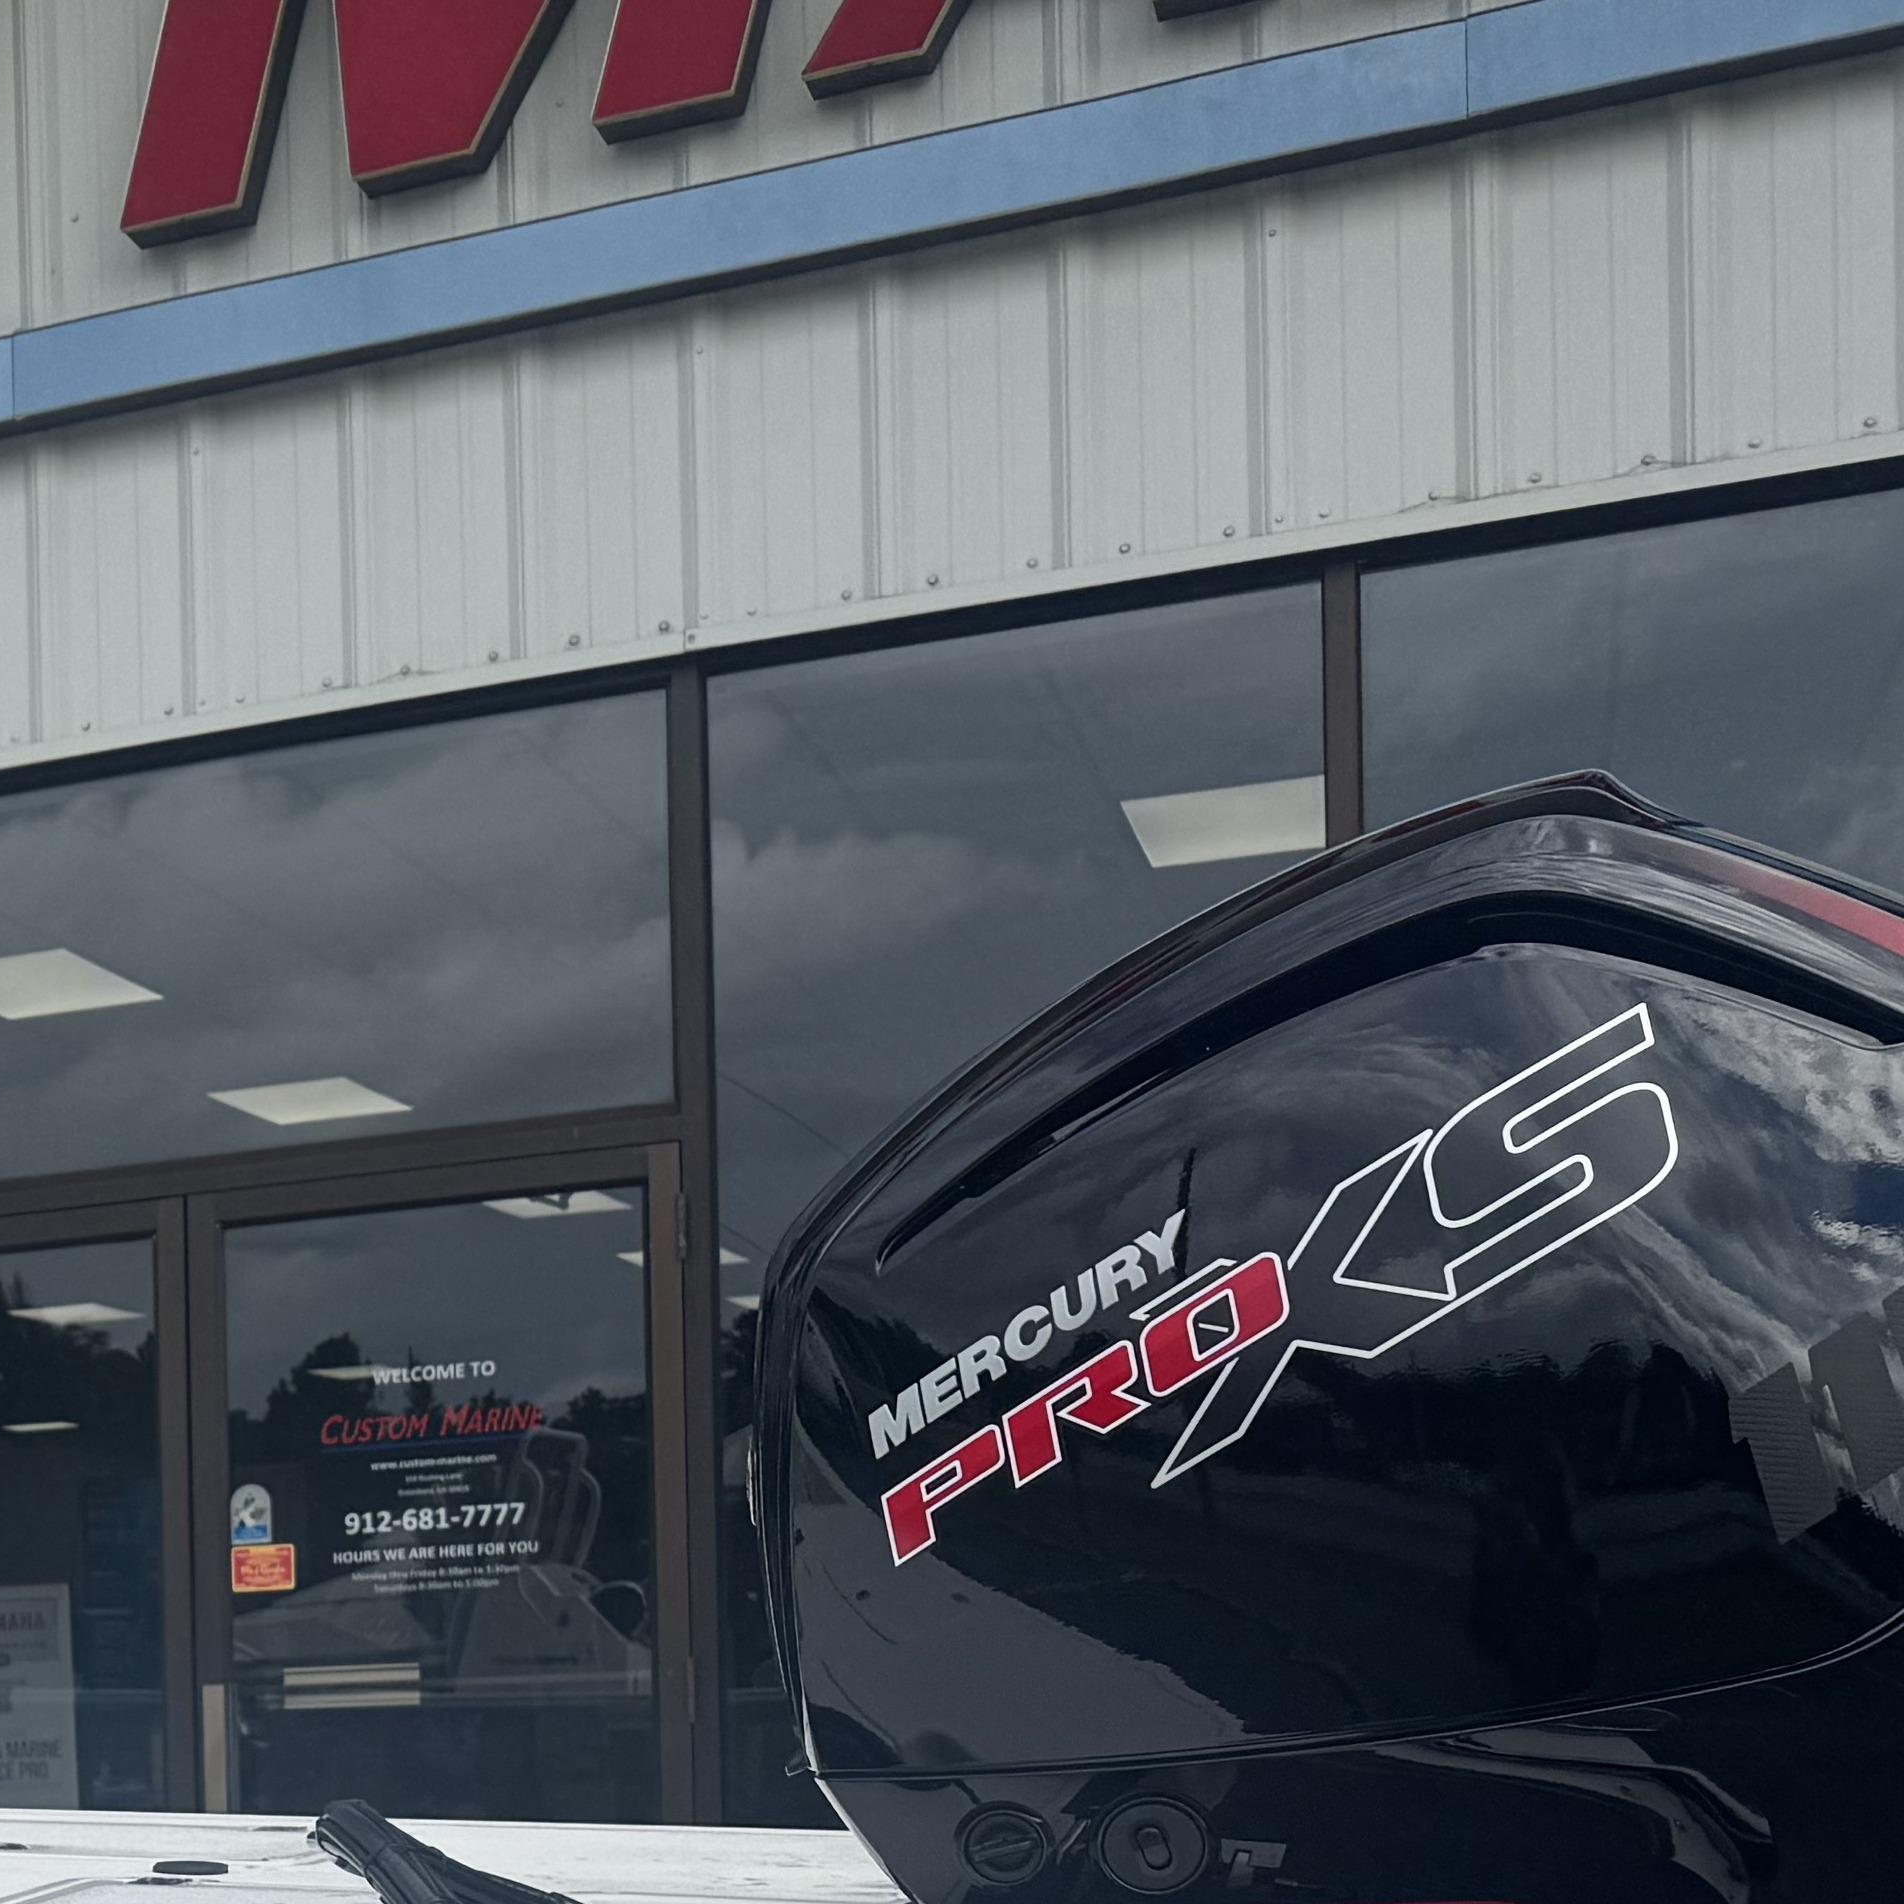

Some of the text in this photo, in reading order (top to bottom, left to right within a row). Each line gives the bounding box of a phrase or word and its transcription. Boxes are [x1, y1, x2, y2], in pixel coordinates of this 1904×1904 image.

[880, 1002, 1679, 1566] PRO XS
[874, 1208, 1186, 1460] MERCURY
[372, 1360, 496, 1385] WELCOME TO
[320, 1403, 544, 1446] CUSTOM MARINE
[344, 1502, 526, 1535] 912-681-7777
[333, 1540, 539, 1565] HOURS WE ARE HERE FOR YOU
